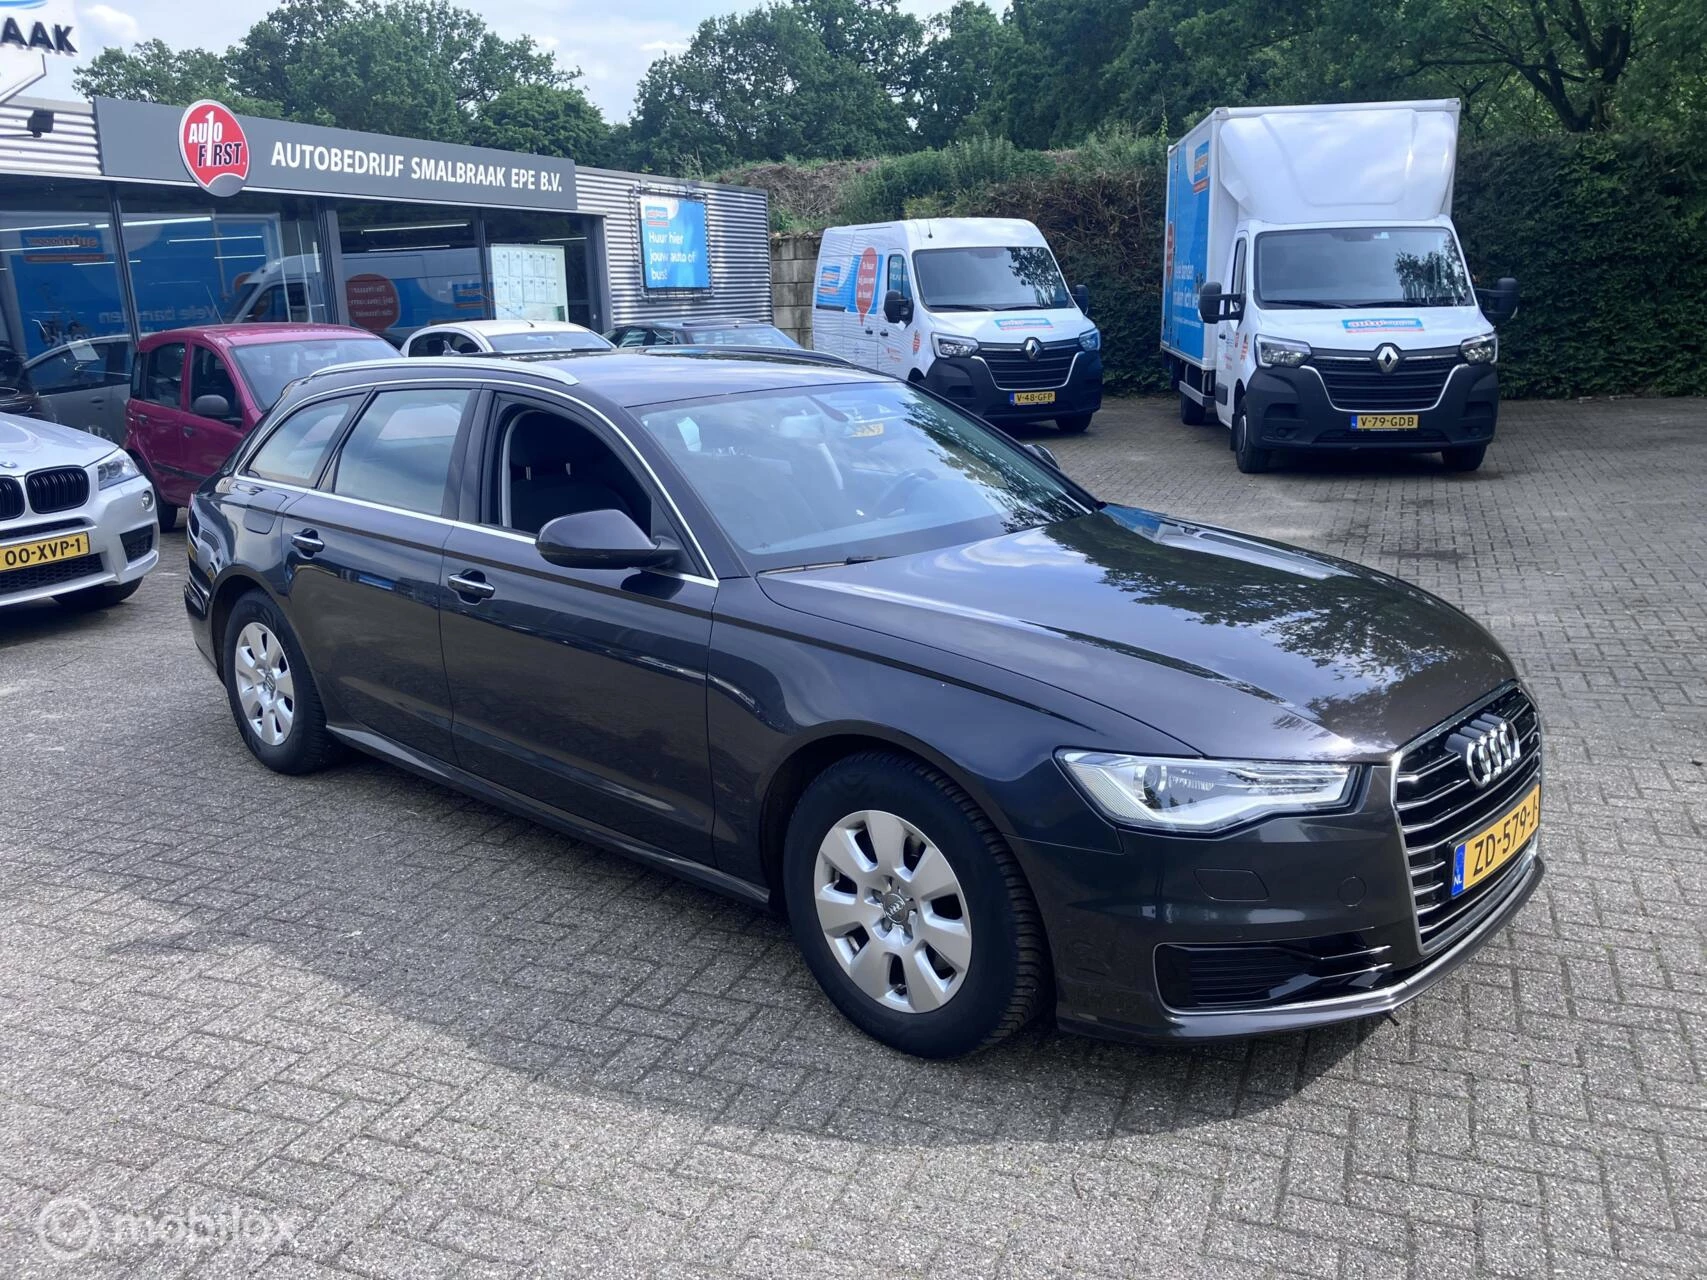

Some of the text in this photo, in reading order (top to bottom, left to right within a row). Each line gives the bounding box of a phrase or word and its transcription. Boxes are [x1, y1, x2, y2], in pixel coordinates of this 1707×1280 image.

[271, 141, 562, 192] AUTOBEDRIJF SMALBRAAK EPE B.V.
[1360, 416, 1415, 427] V-79-GDB
[5, 538, 82, 566] 00-XVP-1
[1473, 794, 1536, 877] ZD-579-J
